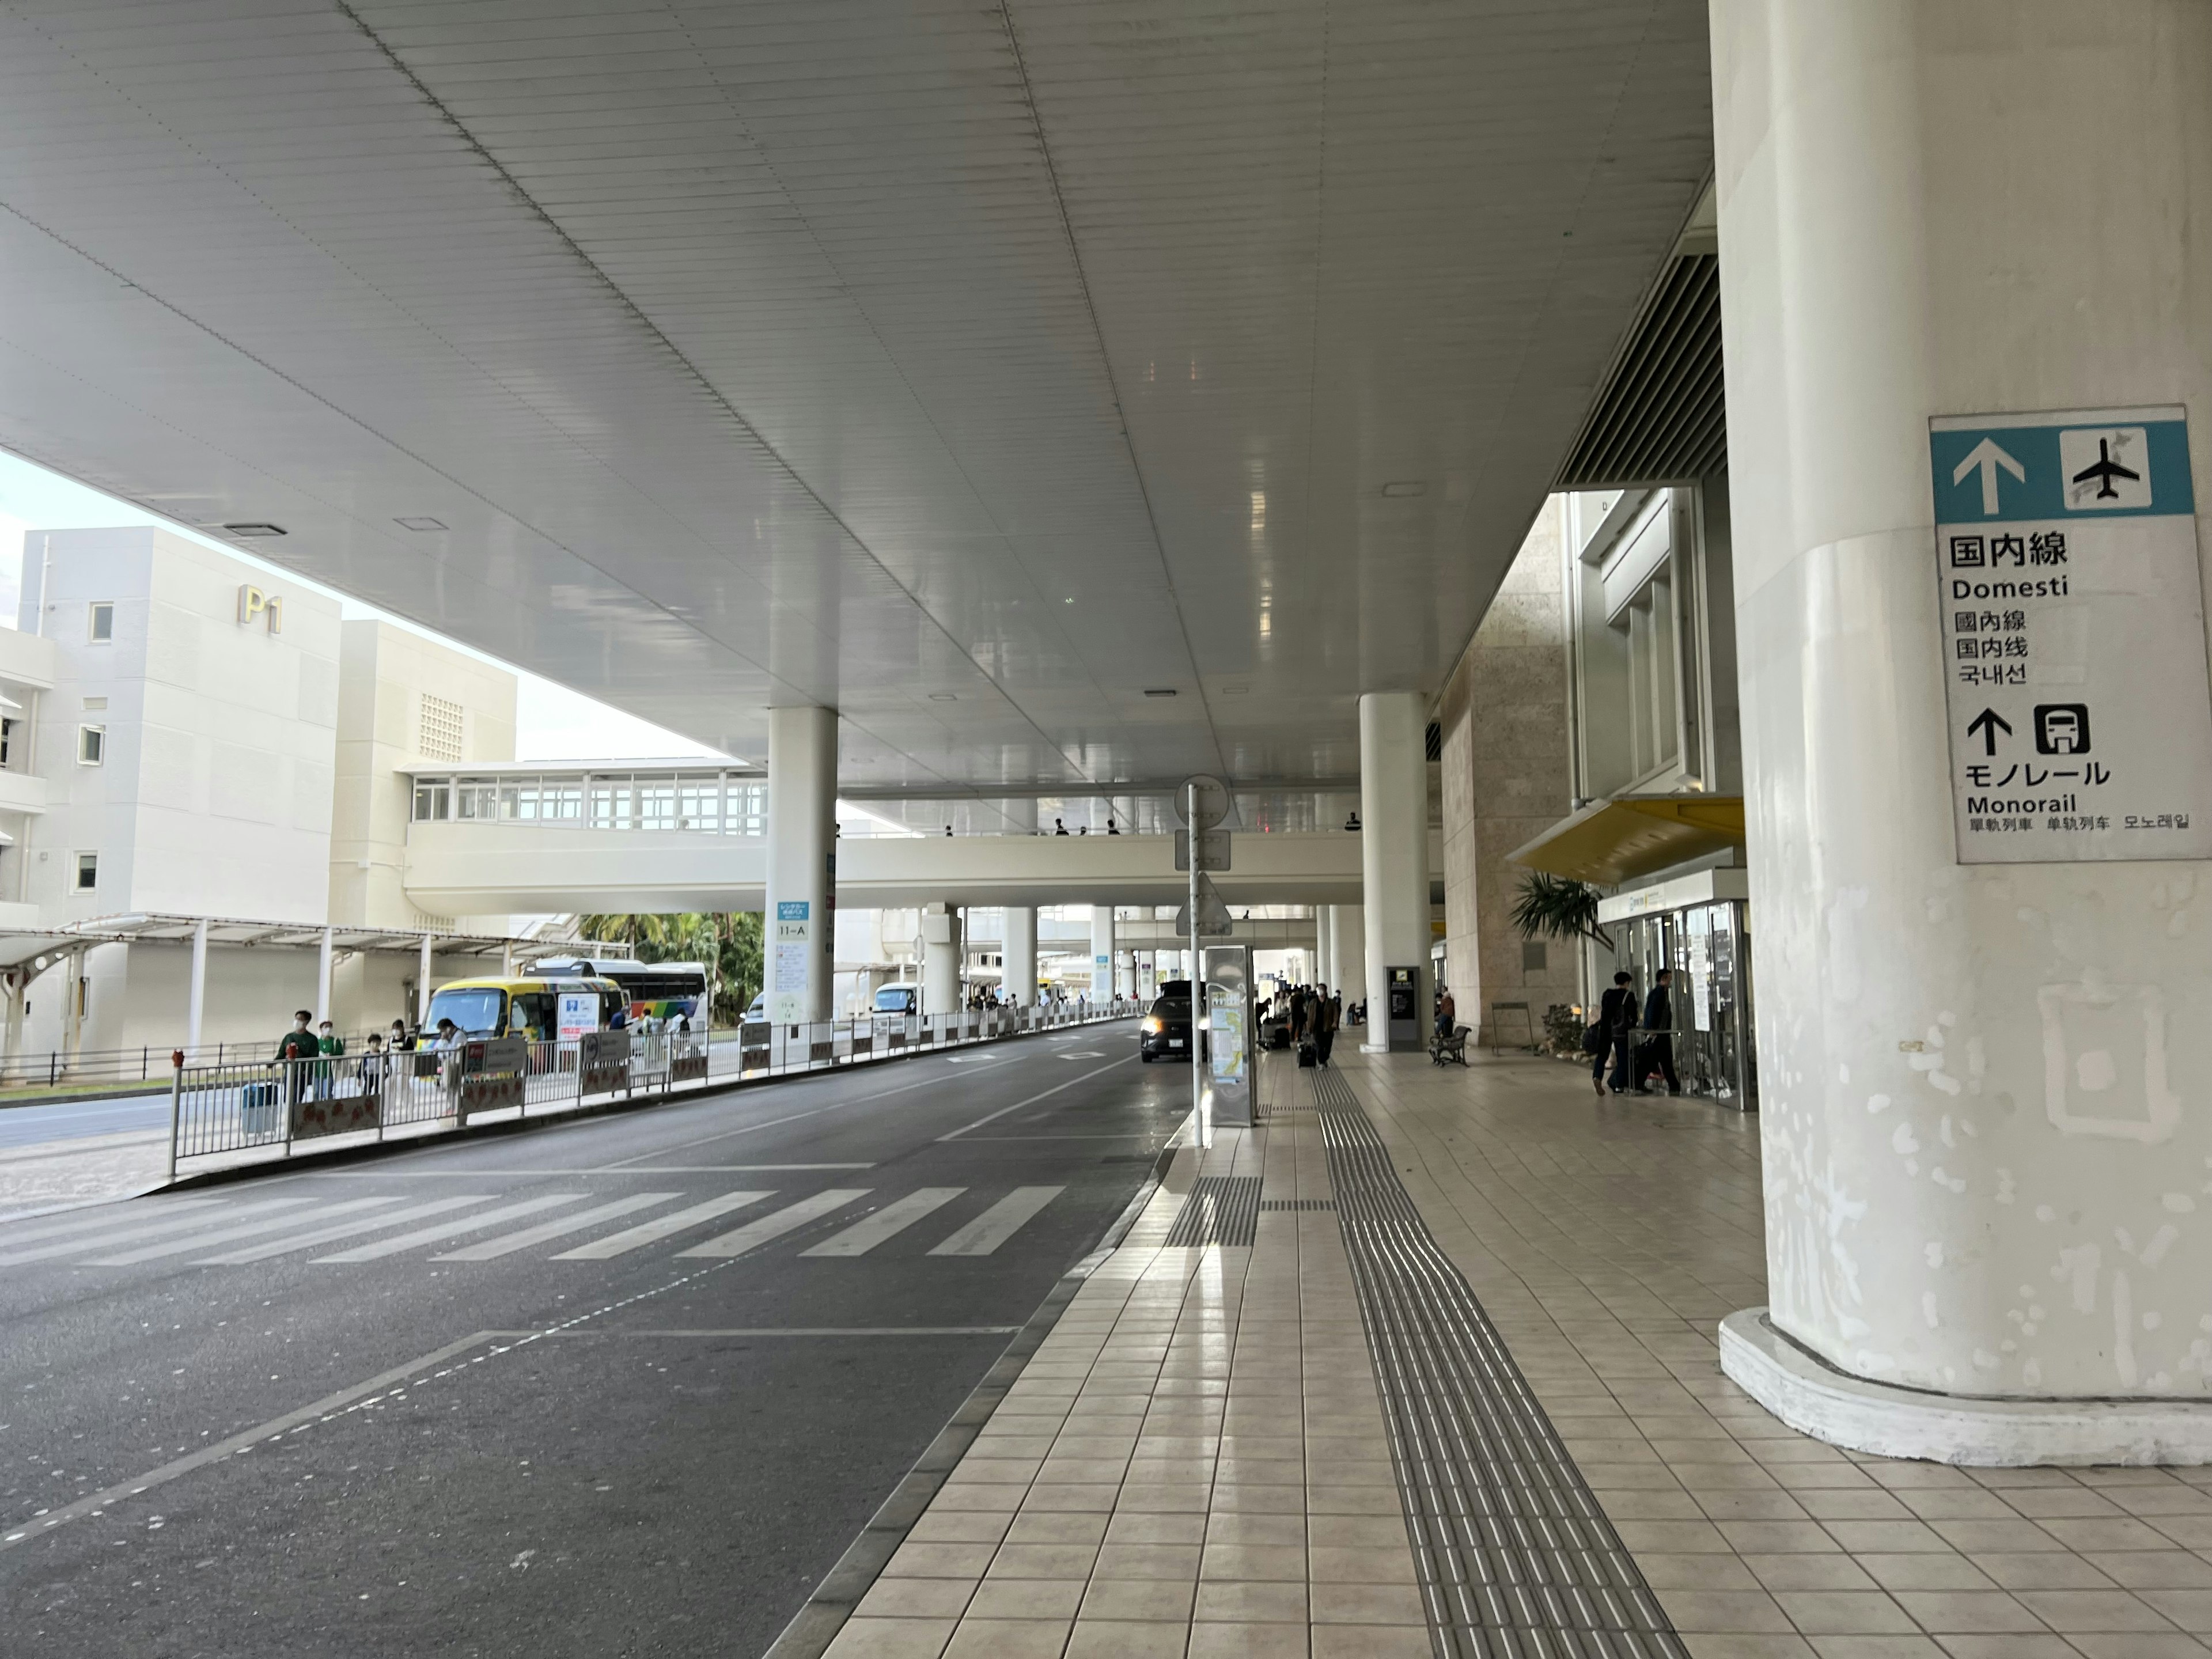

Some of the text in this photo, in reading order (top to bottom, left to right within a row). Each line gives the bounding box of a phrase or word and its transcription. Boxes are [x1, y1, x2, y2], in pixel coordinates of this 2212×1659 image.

[1950, 531, 2068, 567] 国内線
[1953, 575, 2068, 599] Domesti
[239, 584, 282, 634] P1
[1957, 637, 2028, 659] 国内线
[1959, 663, 2027, 686] 국내선
[1966, 762, 2111, 787] モノレール
[1968, 794, 2075, 813] Monorail
[2124, 813, 2189, 830] 모노레일
[781, 926, 805, 935] 11-A
